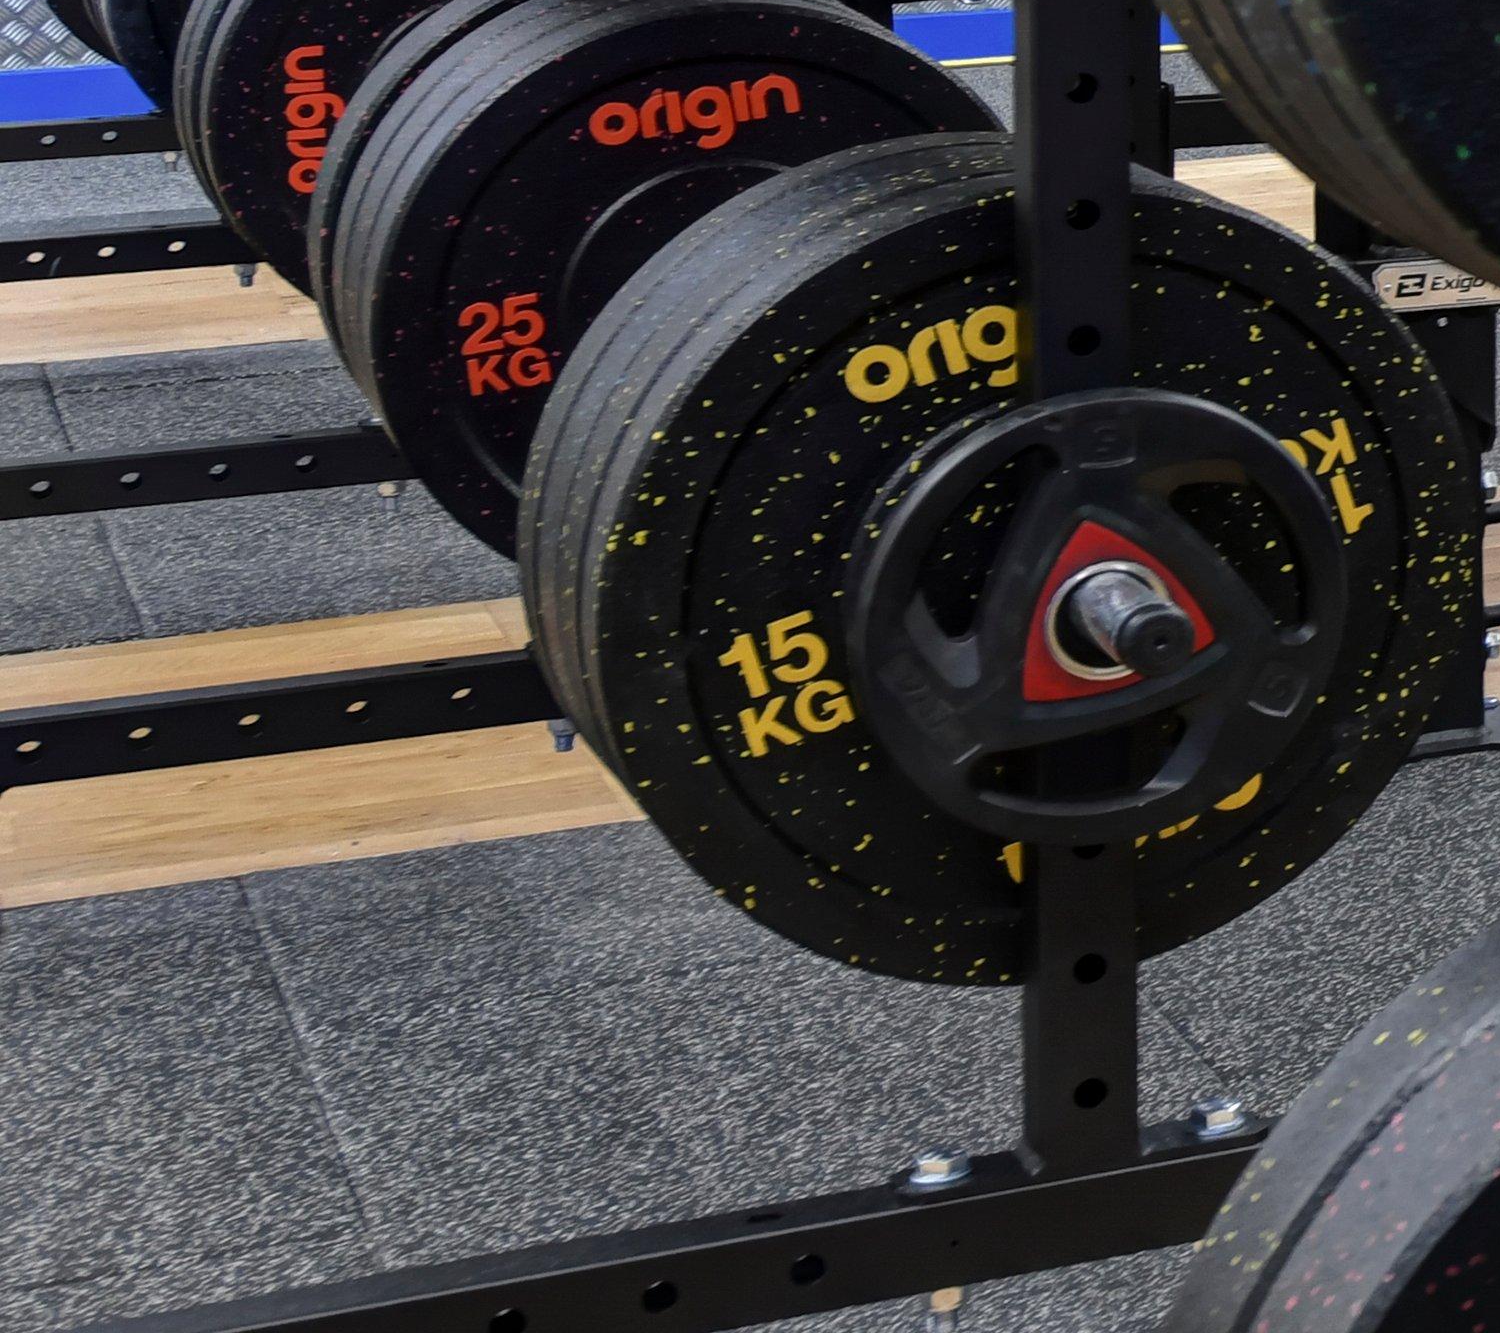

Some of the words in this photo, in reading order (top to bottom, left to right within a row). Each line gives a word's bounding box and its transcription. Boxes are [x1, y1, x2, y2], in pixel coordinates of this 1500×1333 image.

[590, 76, 799, 148] origin
[1431, 275, 1485, 293] Exigo
[457, 293, 545, 357] 25
[844, 306, 1018, 403] orig
[467, 347, 552, 396] KG
[719, 611, 828, 697] 15
[738, 680, 856, 757] KG
